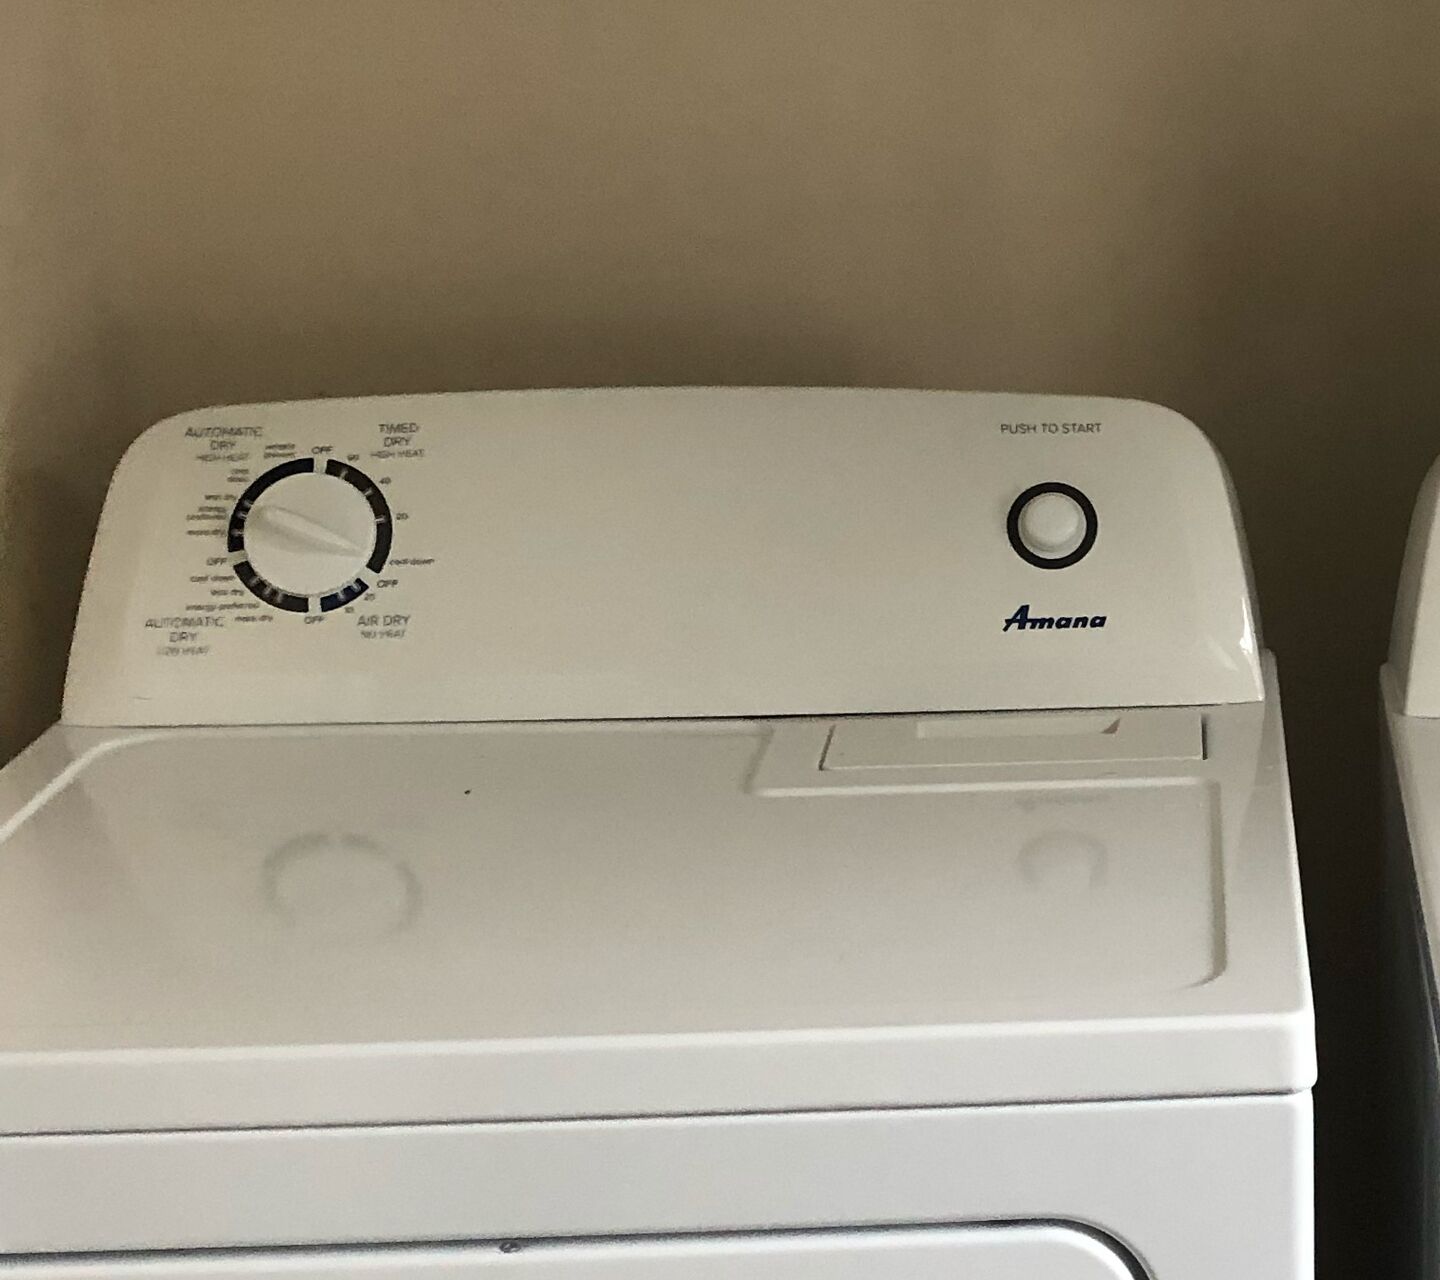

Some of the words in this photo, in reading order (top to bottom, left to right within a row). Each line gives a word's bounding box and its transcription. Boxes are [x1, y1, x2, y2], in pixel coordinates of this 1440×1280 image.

[185, 426, 263, 438] AUTOMATIC
[378, 422, 418, 434] TIMED
[1000, 423, 1037, 434] PUSH
[1041, 423, 1059, 434] TO
[1062, 423, 1101, 434] START
[210, 439, 237, 451] DRY
[384, 436, 411, 448] DRY
[311, 446, 333, 455] OFF
[207, 557, 228, 566] OFF
[377, 579, 399, 588] OFF
[304, 615, 325, 625] OFF
[358, 615, 379, 626] AIR
[383, 614, 411, 626] DRY
[1002, 604, 1107, 632] Amana
[169, 631, 198, 643] DRY
